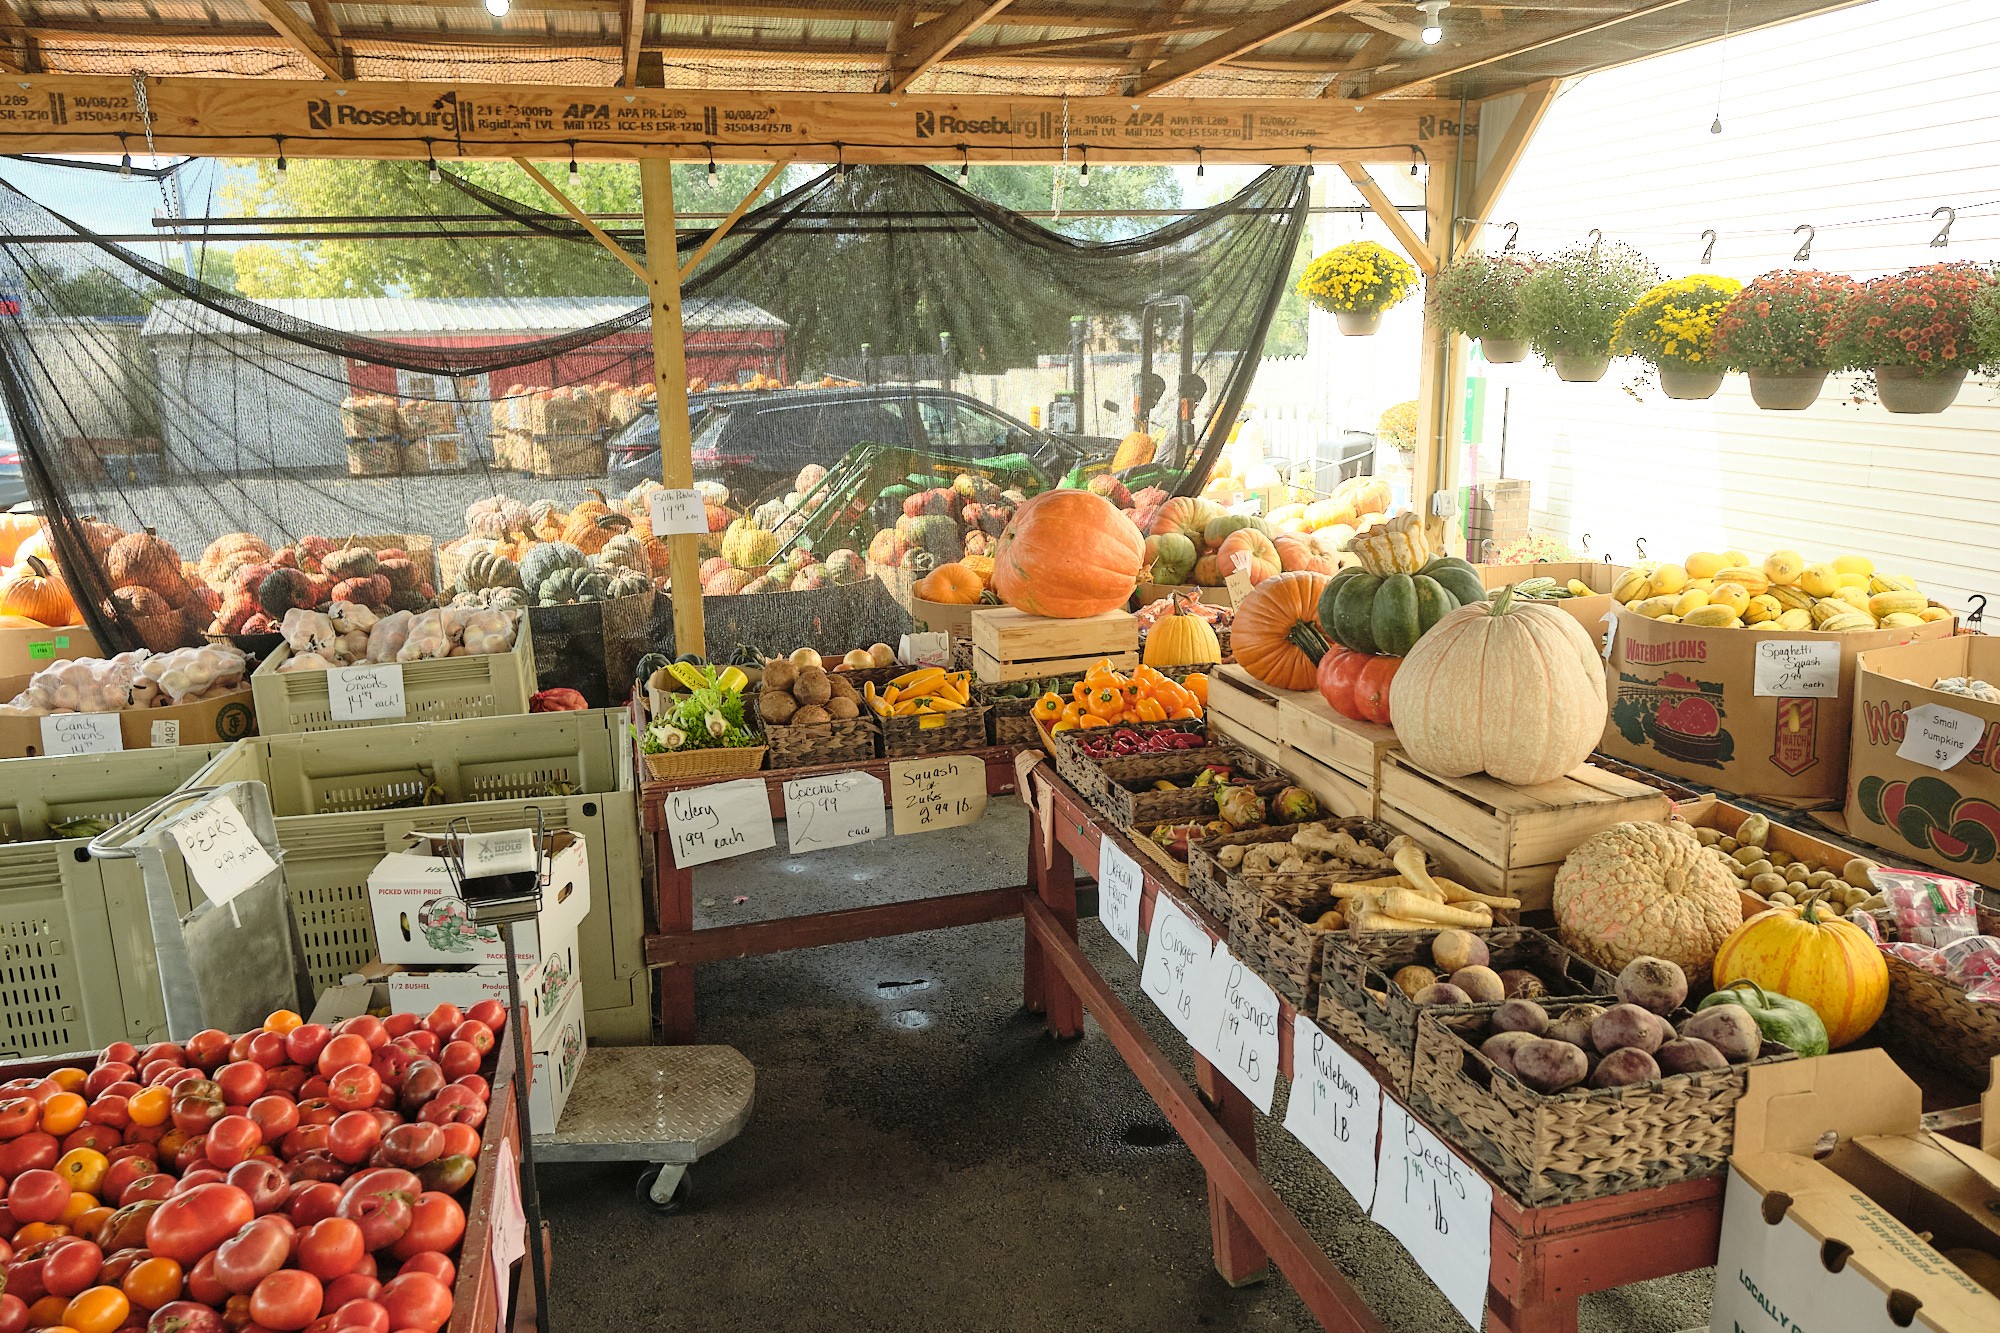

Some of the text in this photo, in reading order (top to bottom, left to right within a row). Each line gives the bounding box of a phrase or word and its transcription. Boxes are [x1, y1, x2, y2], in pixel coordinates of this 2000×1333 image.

[73, 97, 129, 108] 10/08/22
[562, 103, 610, 119] APA
[75, 110, 158, 122] 315043475B
[338, 104, 459, 131] Roseburg
[617, 108, 686, 118] APA PR-L289
[724, 110, 768, 120] 10/08/22
[1084, 115, 1117, 124] 3100Fb
[1125, 112, 1164, 126] APA
[1170, 116, 1188, 125] APA
[1260, 117, 1297, 126] 10/08/22
[564, 120, 610, 130] Mill 1125
[656, 121, 702, 132] ESR-1210
[940, 114, 1038, 139] Roseburg
[1125, 128, 1142, 137] Mill
[1626, 637, 1707, 663] WATERMELONS
[1762, 643, 1812, 660] Spaghetti
[1783, 656, 1821, 675] Squash
[341, 668, 378, 684] Candy
[1803, 681, 1824, 690] each
[56, 718, 97, 732] Candy
[1932, 715, 1958, 731] Small
[1783, 734, 1807, 748] WATCH
[1923, 728, 1964, 749] Pumpkins
[1784, 748, 1802, 761] STEP
[1935, 749, 1948, 761] $3
[903, 763, 958, 788] Squash
[789, 780, 851, 802] Coconuts
[674, 796, 719, 830] Celery
[185, 815, 238, 861] PEARS
[714, 827, 745, 849] each
[848, 827, 870, 838] each
[1106, 847, 1133, 891] DRAGON
[1160, 914, 1197, 967] Ginger
[1177, 989, 1191, 1020] LB
[1225, 963, 1276, 1036] Parsnips
[1239, 1041, 1260, 1082] LB
[1334, 1102, 1350, 1143] LB
[1403, 1114, 1466, 1201] Beets
[1849, 1193, 1983, 1296] KEEP REFRIGERATED
[1855, 1213, 1939, 1276] PERISHABLE
[1739, 1268, 1790, 1328] LOCALLY
